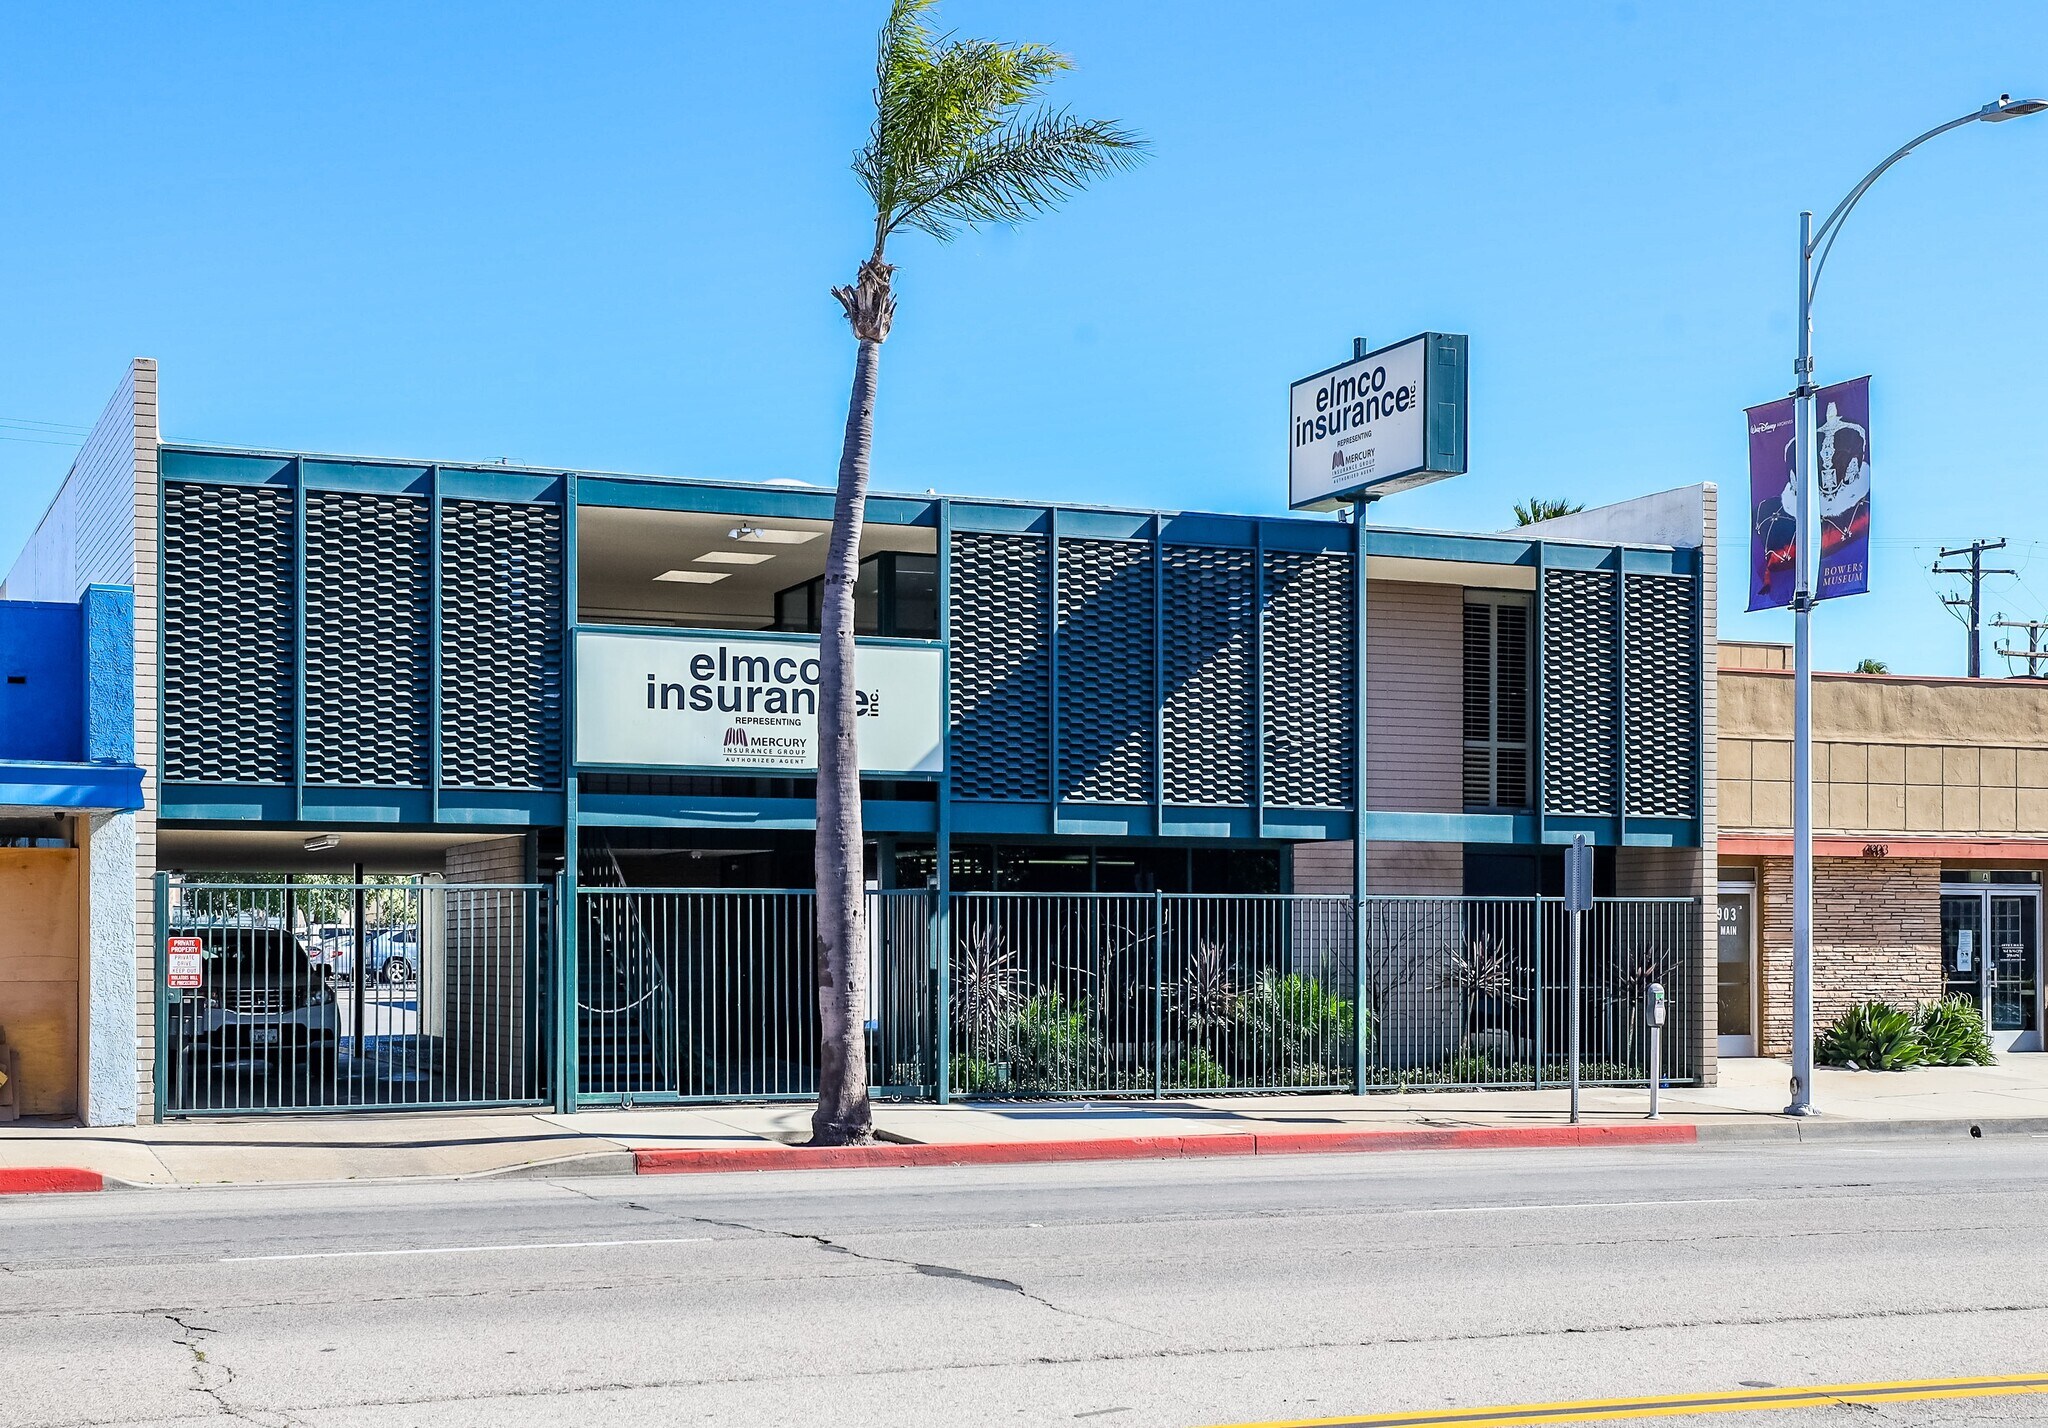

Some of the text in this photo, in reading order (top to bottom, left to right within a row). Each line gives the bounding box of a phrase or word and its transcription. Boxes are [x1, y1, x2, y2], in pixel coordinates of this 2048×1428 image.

[1316, 366, 1386, 412] elmco
[1296, 385, 1410, 447] insurance
[1337, 430, 1372, 447] REPRESENTING
[1345, 448, 1375, 464] MERCURY
[1332, 464, 1358, 475] INSURANCE
[1824, 562, 1863, 576] BOWERS
[1823, 572, 1863, 586] MUSEUM
[690, 646, 820, 685] elmco
[647, 673, 869, 717] insurane
[867, 688, 879, 717] inc.
[735, 716, 801, 726] REPRESENTING
[751, 737, 807, 747] MERCURY
[1720, 926, 1737, 935] MAIN
